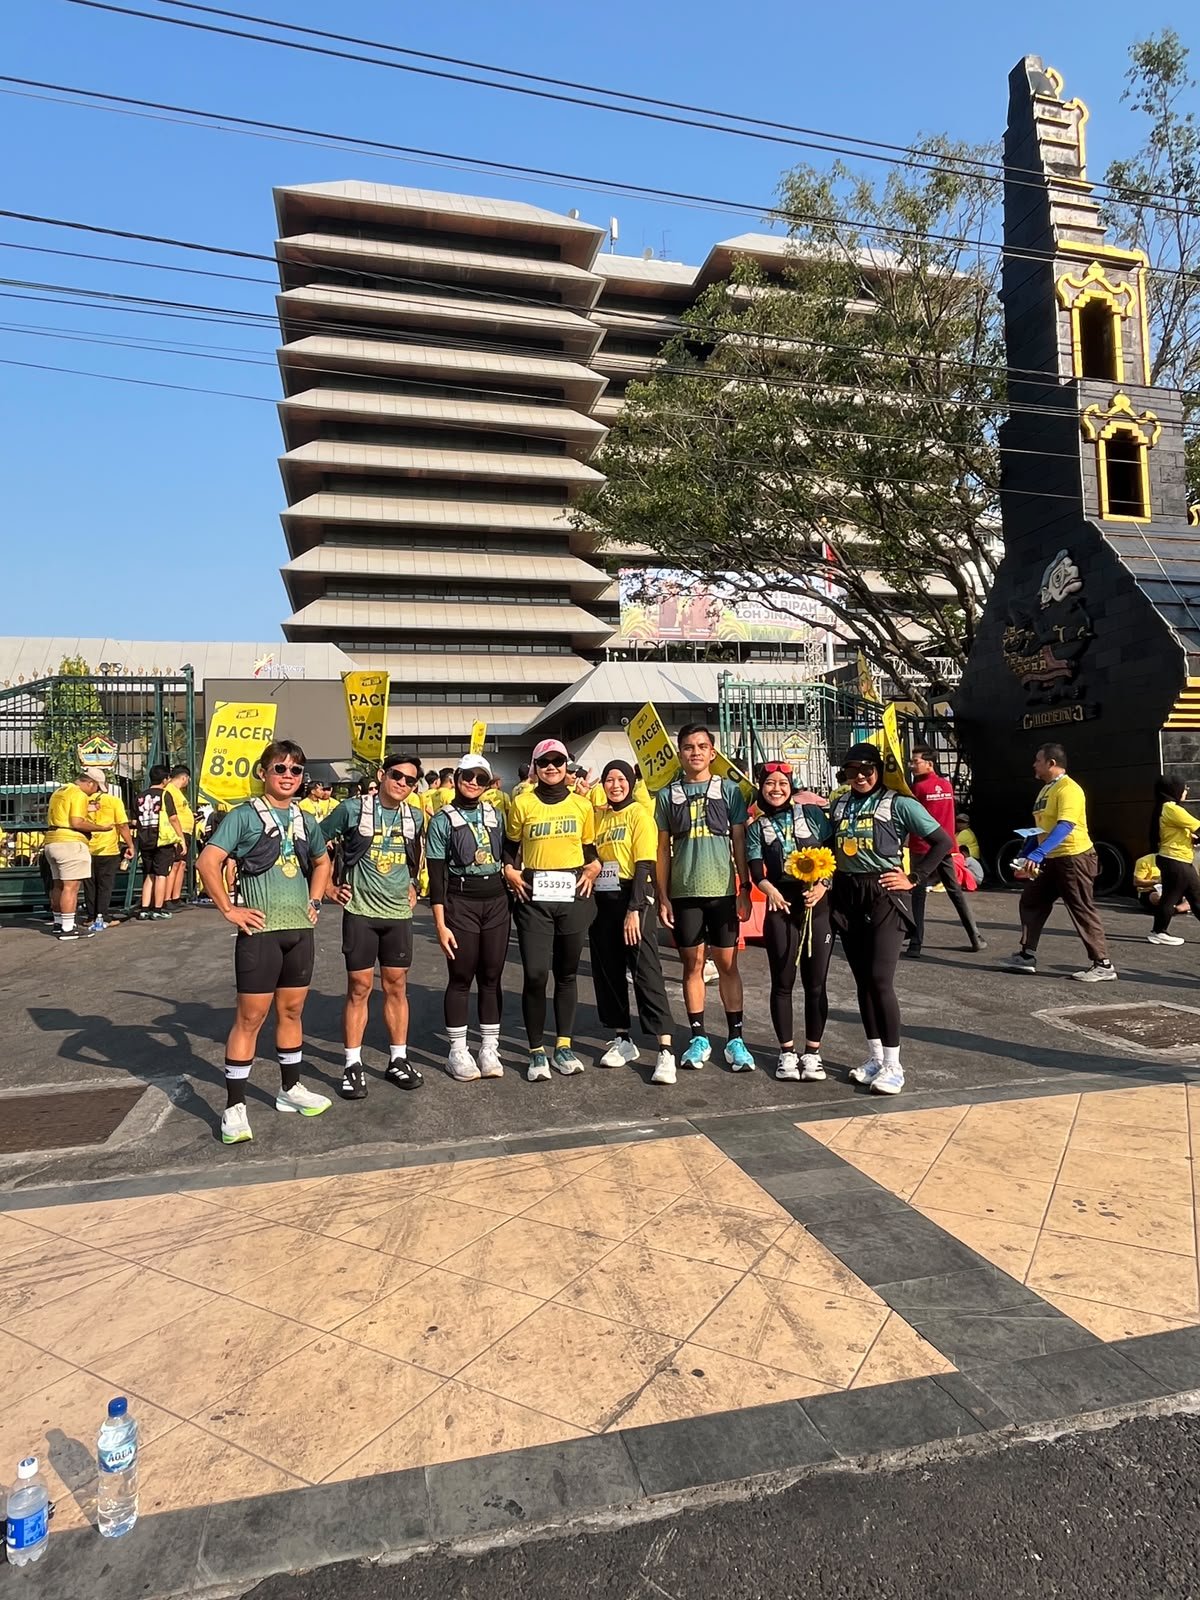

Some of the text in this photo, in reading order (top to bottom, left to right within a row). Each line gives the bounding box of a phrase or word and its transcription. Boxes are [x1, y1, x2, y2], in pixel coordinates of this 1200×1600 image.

[736, 609, 761, 619] LOH
[216, 725, 273, 743] PACER
[635, 719, 662, 751] PACER
[213, 747, 228, 755] SUB
[644, 744, 674, 776] 7:30
[529, 822, 552, 839] FUN
[538, 880, 572, 889] 553975
[108, 1447, 133, 1463] AQUA
